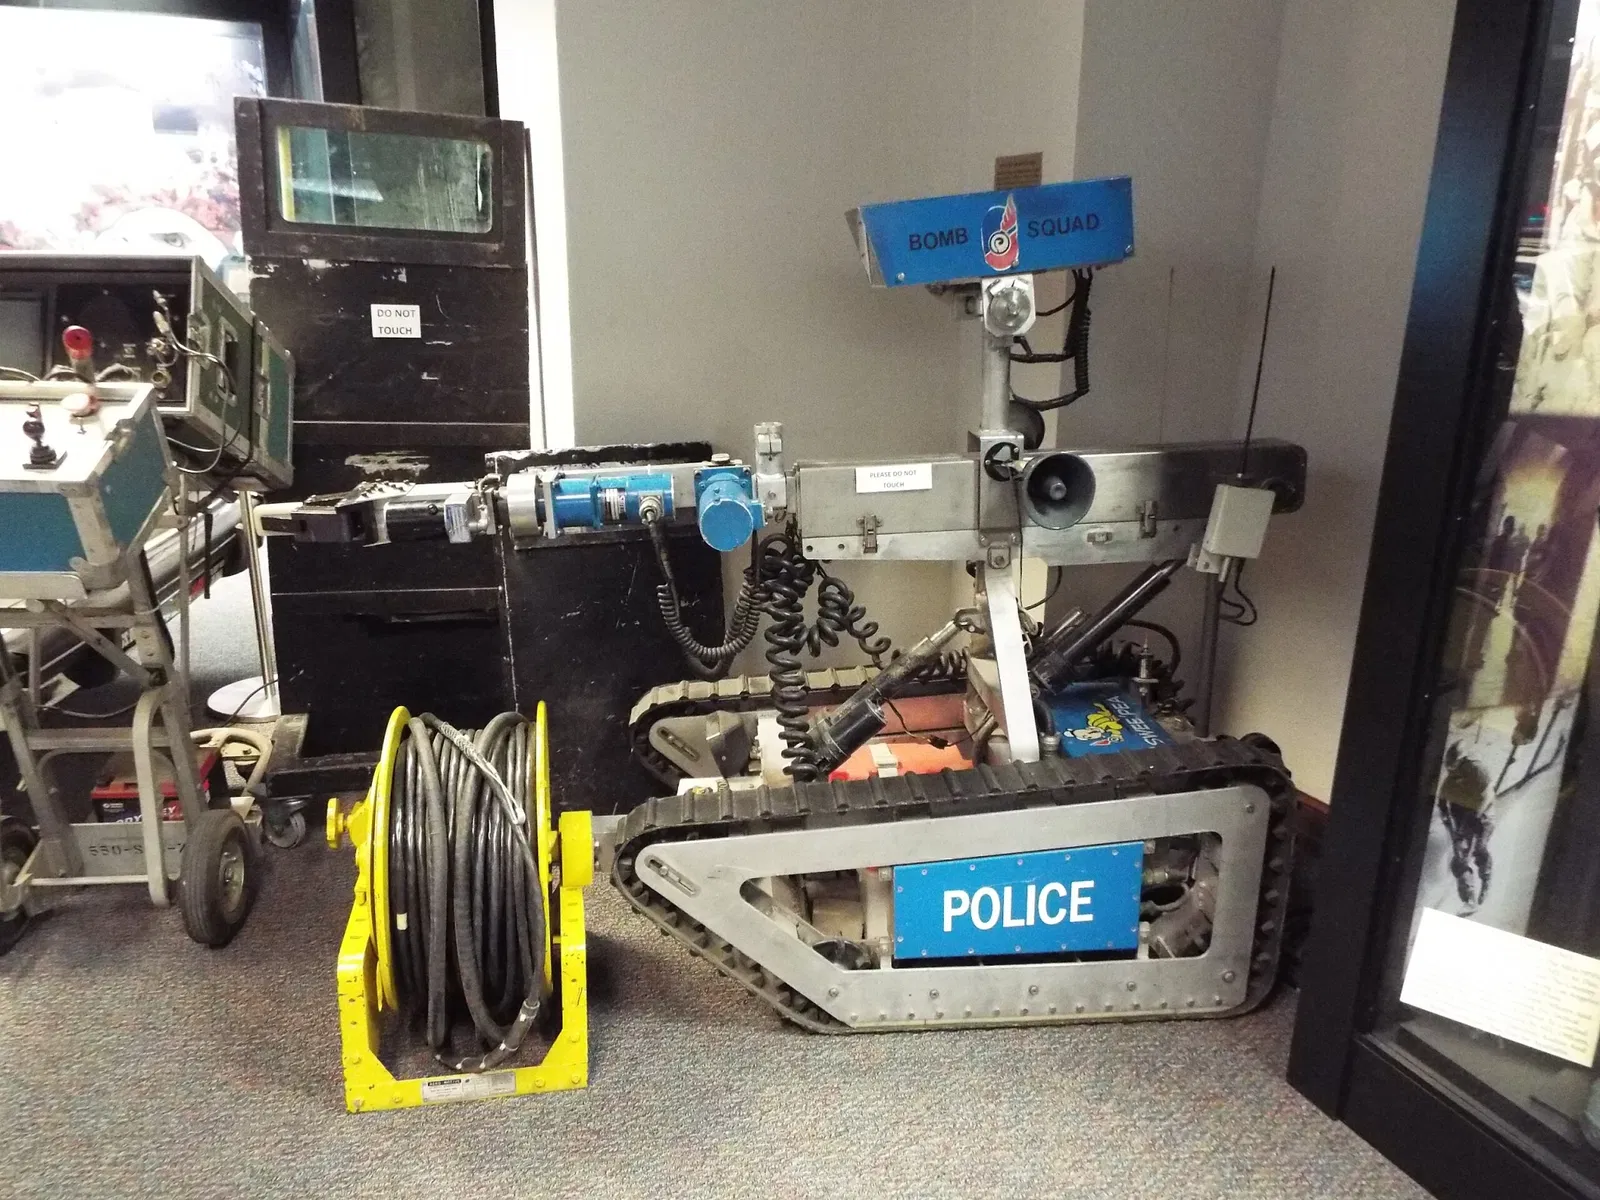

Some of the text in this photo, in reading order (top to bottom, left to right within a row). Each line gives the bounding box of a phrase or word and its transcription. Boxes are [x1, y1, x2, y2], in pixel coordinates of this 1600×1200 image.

[908, 213, 1100, 251] BOMB SQUAD
[377, 309, 416, 318] DO NOT
[378, 326, 412, 335] TOUCH
[883, 481, 905, 489] TOUCH
[943, 880, 1095, 932] POLICE
